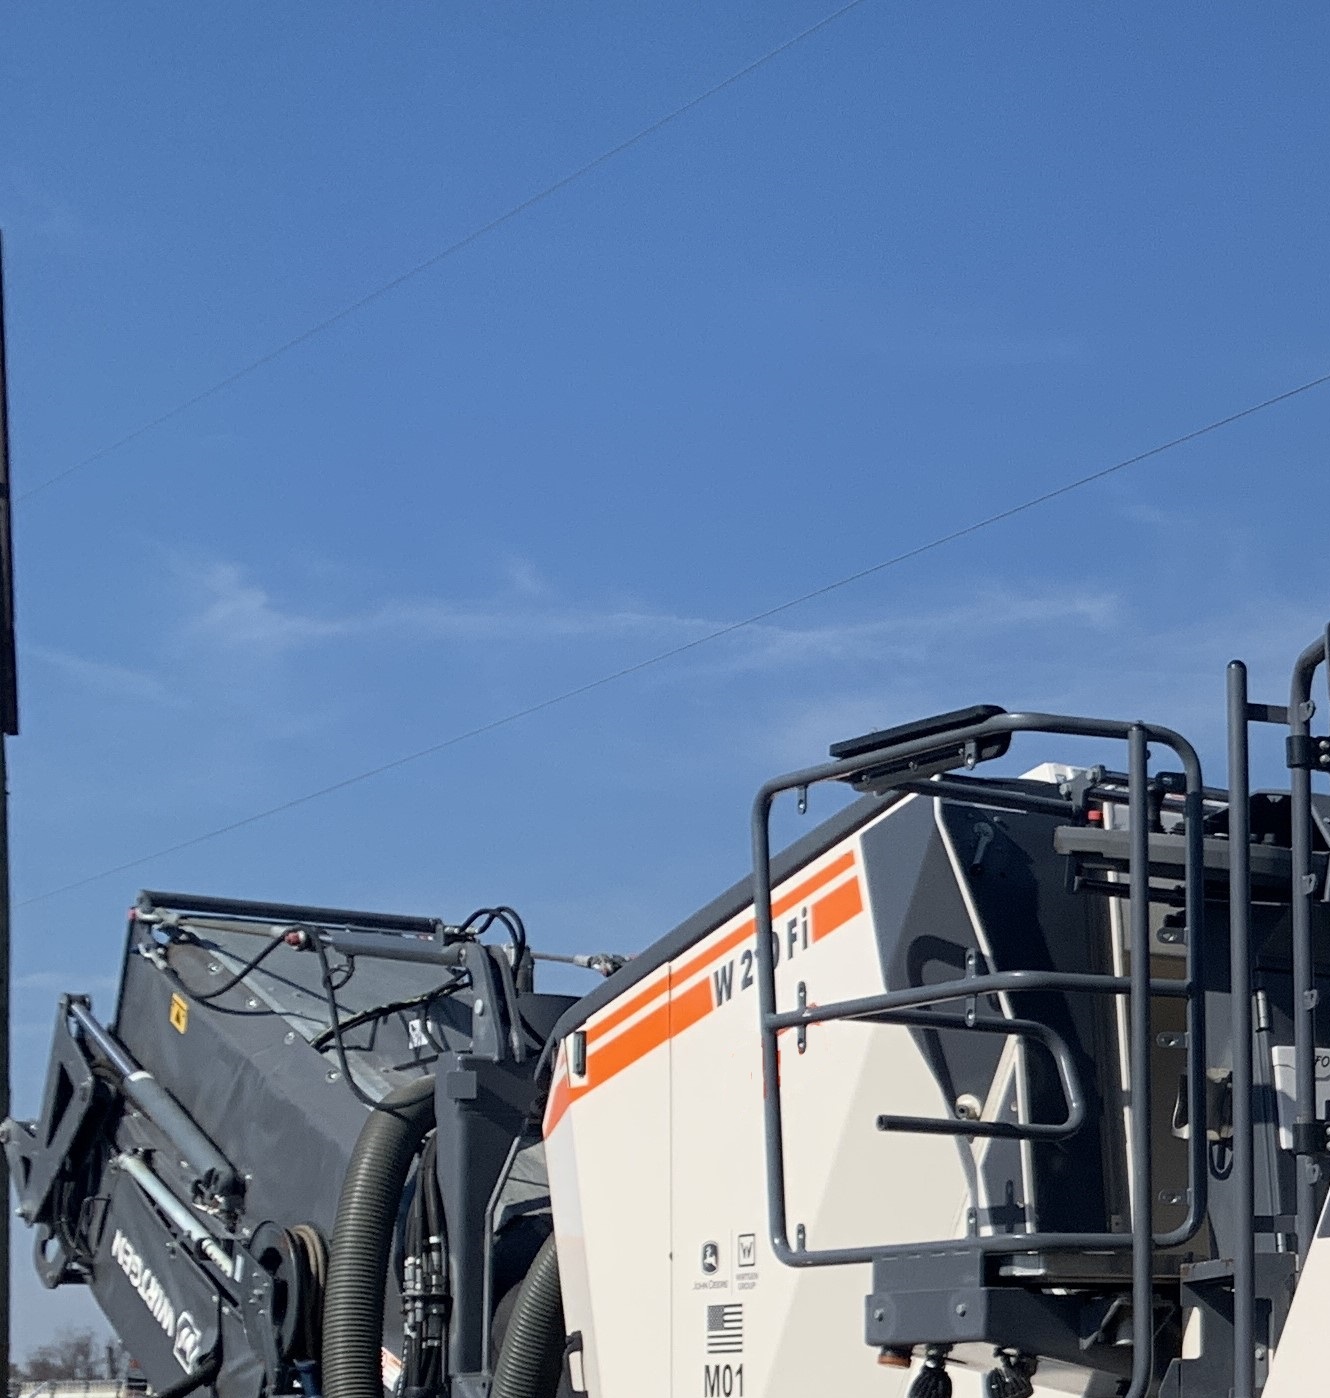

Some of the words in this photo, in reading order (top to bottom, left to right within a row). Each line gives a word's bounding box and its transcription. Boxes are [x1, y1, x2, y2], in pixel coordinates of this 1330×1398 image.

[713, 960, 734, 1007] W
[787, 906, 808, 960] Fi
[112, 1229, 175, 1337] WIRTGEN
[692, 1280, 708, 1290] JOHN
[704, 1363, 744, 1398] M01
